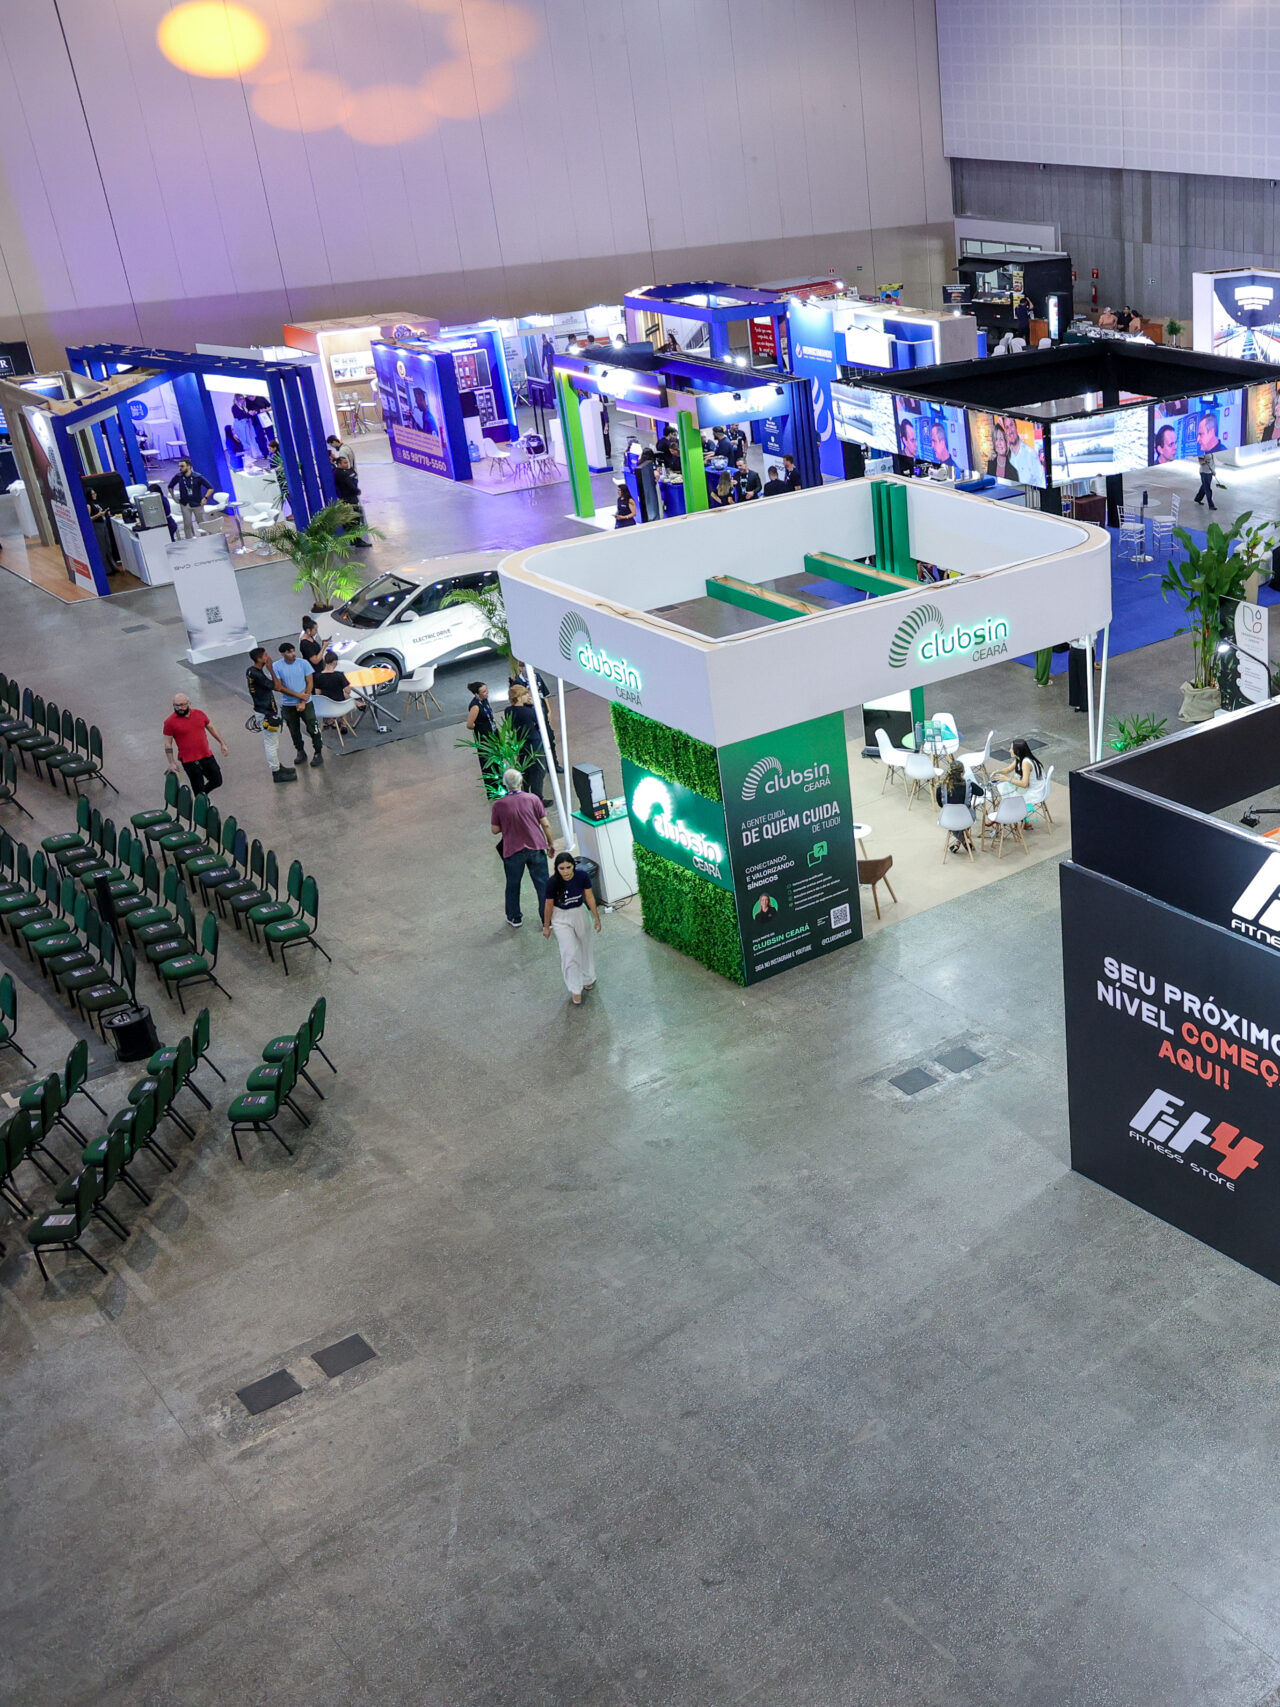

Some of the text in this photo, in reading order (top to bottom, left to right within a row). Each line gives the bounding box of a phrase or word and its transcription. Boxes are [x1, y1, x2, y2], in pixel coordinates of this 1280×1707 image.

[921, 618, 1008, 660] clubsin
[972, 640, 1008, 662] CEARÁ
[578, 643, 642, 691] clubsin
[615, 685, 642, 706] CEARÁ
[765, 762, 830, 794] clubsin
[803, 776, 831, 793] CEARÁ
[741, 809, 786, 830] A GENTE CUIDA
[742, 800, 840, 847] DE QUEM CUIDA
[812, 817, 841, 834] DE TUDO!
[652, 813, 723, 863] clubsin
[692, 855, 722, 880] CEARÁ
[745, 854, 787, 874] CONECTANDO
[746, 860, 795, 883] E VALORIZANDO
[747, 874, 779, 891] SÍNDICOS
[752, 935, 784, 951] CLUBSIN
[785, 922, 810, 939] CEARÁ
[1103, 956, 1156, 996] SEU
[1097, 980, 1174, 1035] NÍVEL
[1158, 1039, 1231, 1091] AQUI!
[1129, 1130, 1235, 1192] FITNESS STORE
